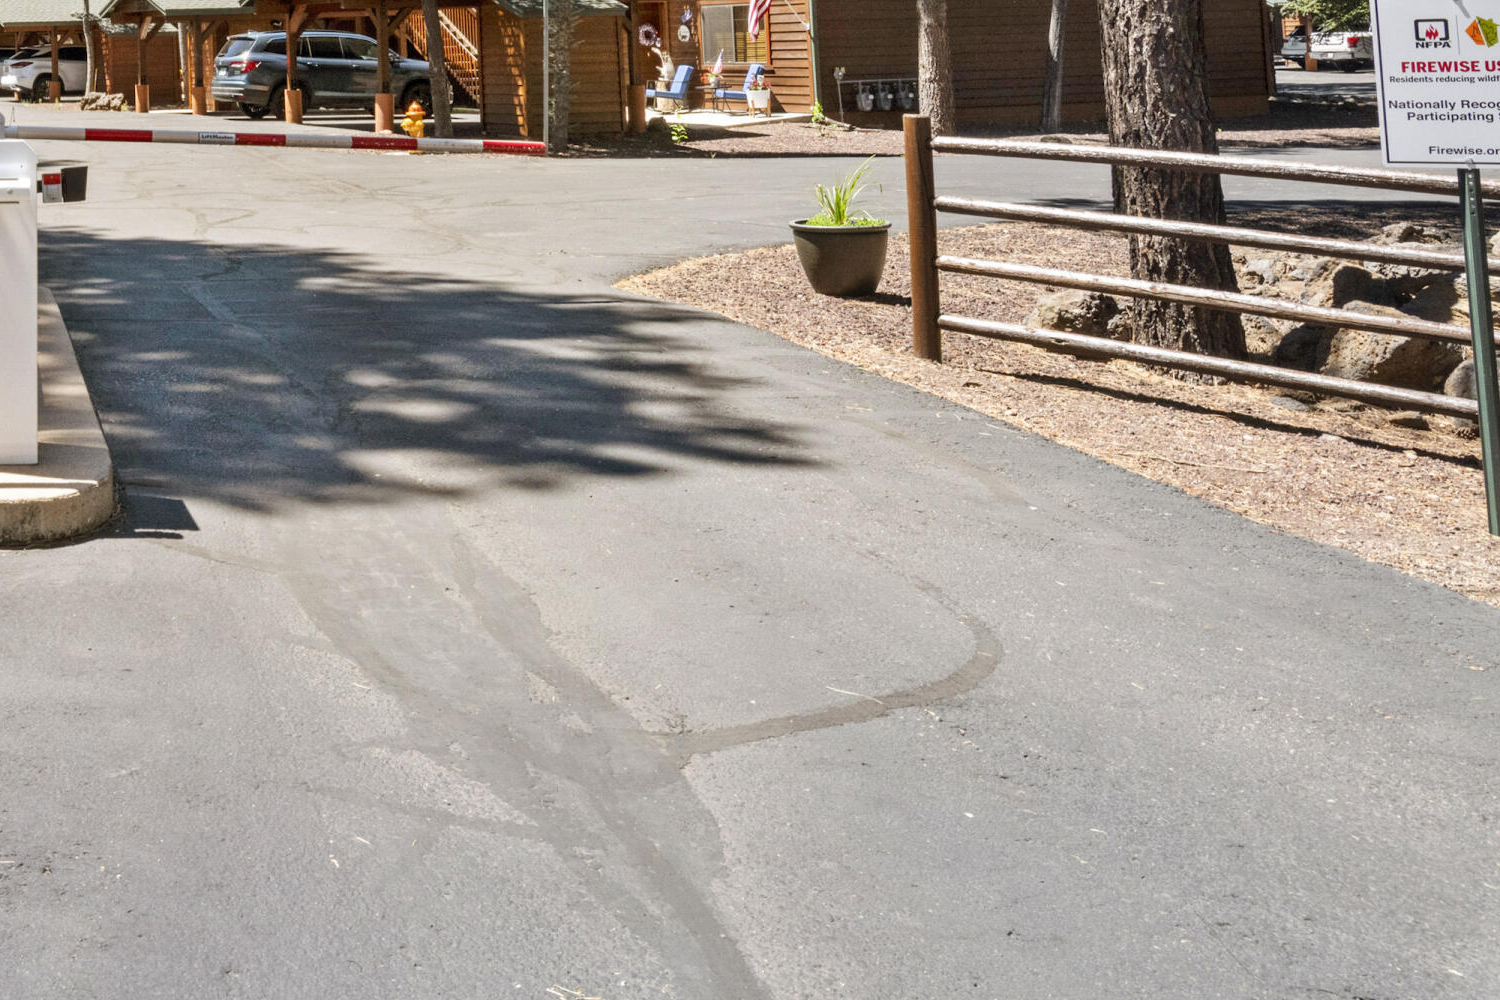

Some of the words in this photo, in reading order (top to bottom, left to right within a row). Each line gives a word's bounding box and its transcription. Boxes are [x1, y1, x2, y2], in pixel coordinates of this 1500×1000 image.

[1415, 41, 1451, 49] NFPA
[1401, 60, 1481, 73] FIREWISE
[1389, 75, 1434, 83] Residents
[1435, 75, 1476, 84] reducing
[1388, 100, 1456, 111] Nationally
[1407, 111, 1494, 123] Participating
